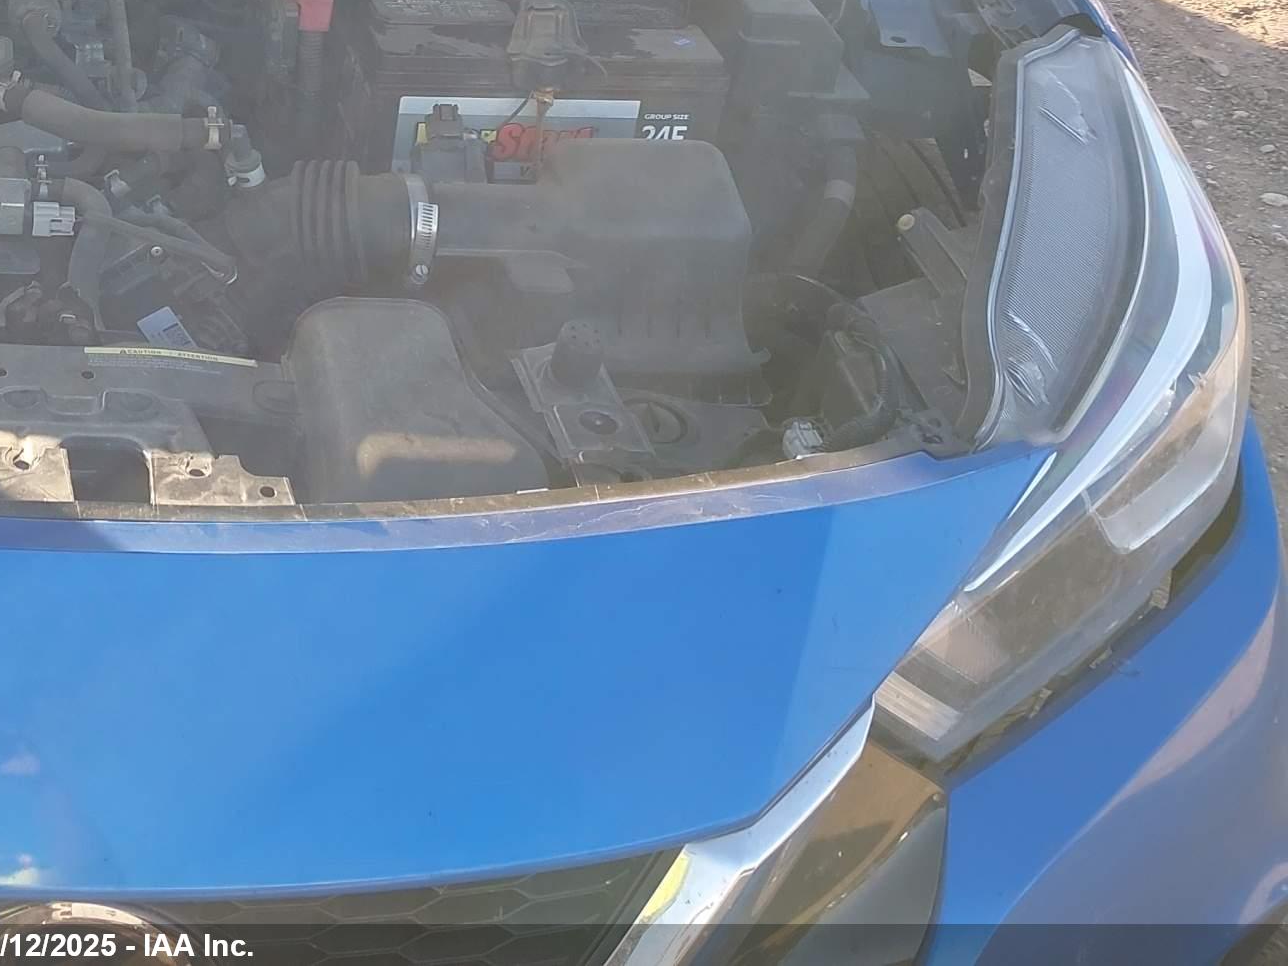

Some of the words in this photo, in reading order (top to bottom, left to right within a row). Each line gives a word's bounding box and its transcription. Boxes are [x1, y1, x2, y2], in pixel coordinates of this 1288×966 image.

[644, 113, 672, 121] GROUP
[672, 113, 691, 121] SIZE
[177, 352, 219, 362] ATTENTION
